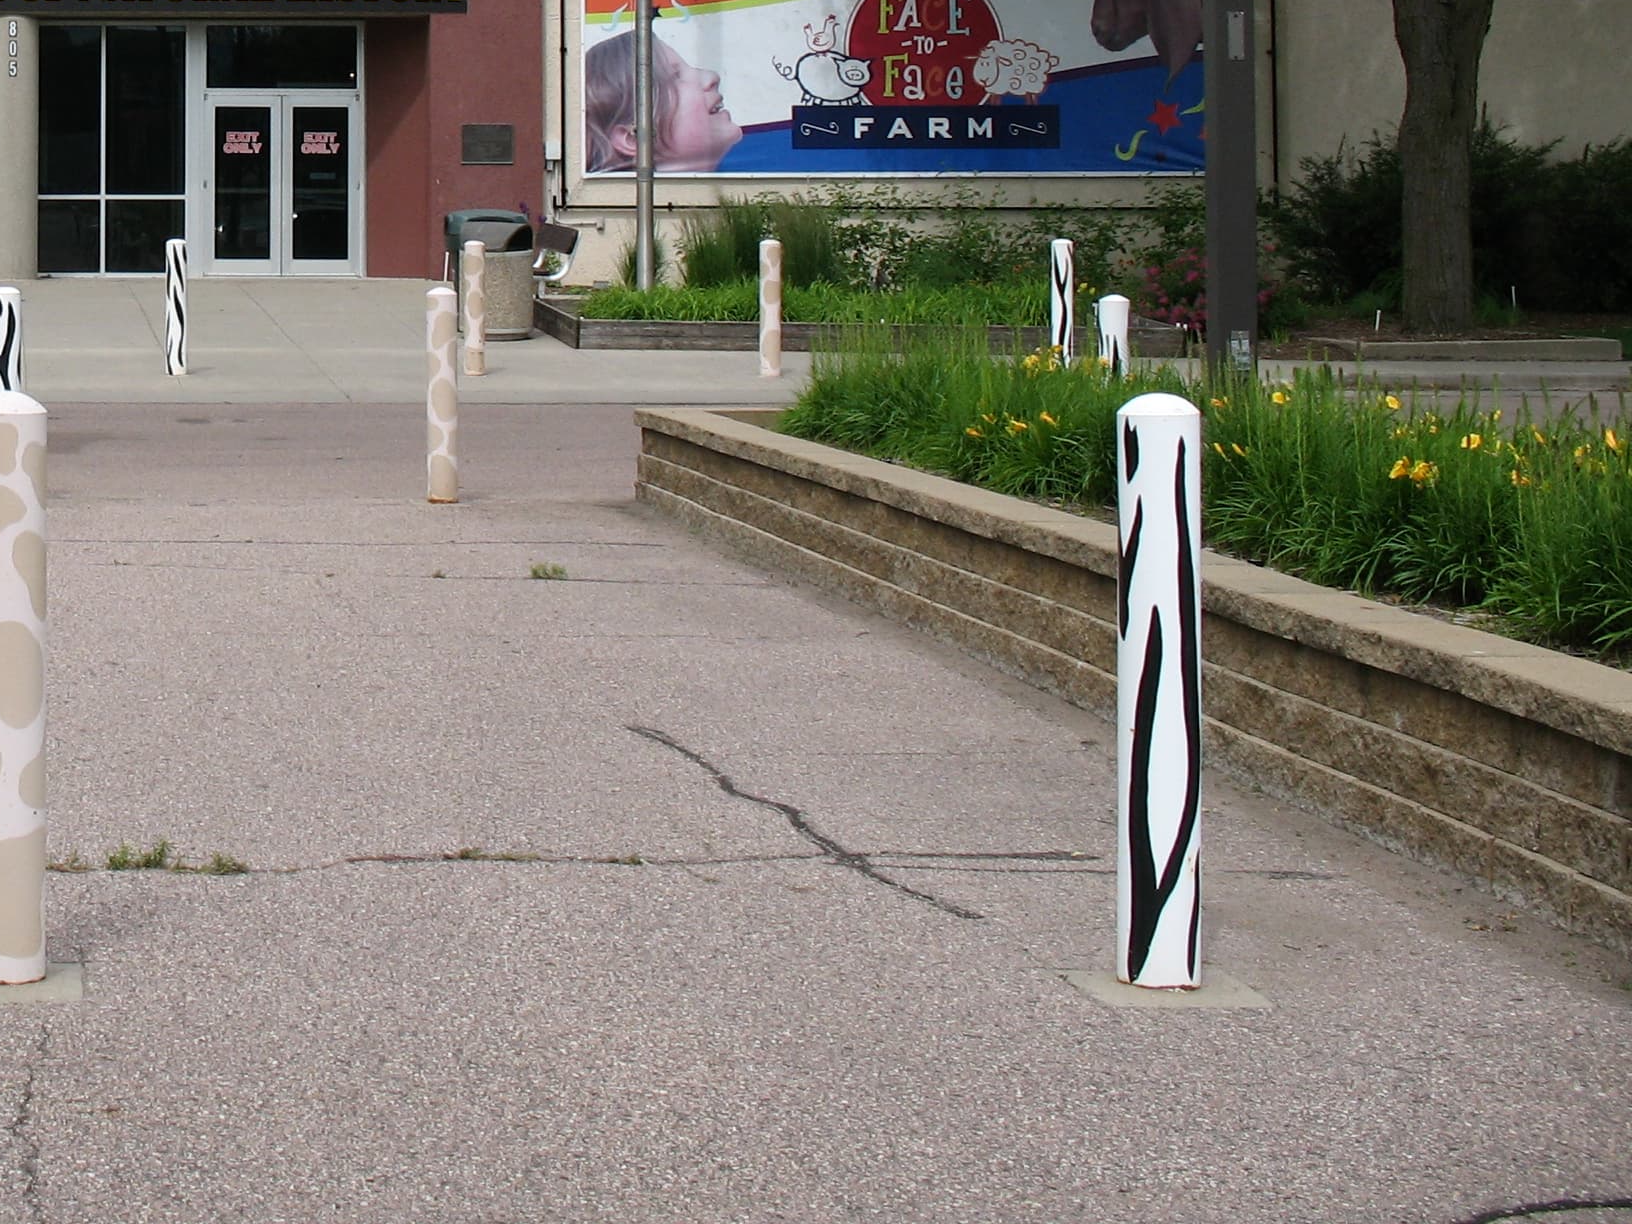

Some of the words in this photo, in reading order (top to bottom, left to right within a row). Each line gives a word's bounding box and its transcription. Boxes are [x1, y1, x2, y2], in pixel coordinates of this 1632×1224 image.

[9, 21, 17, 76] 805
[854, 117, 993, 139] FARM
[226, 131, 260, 142] EXIT
[303, 131, 338, 143] EXIT
[223, 142, 262, 154] ONLY
[301, 143, 340, 154] ONLY
